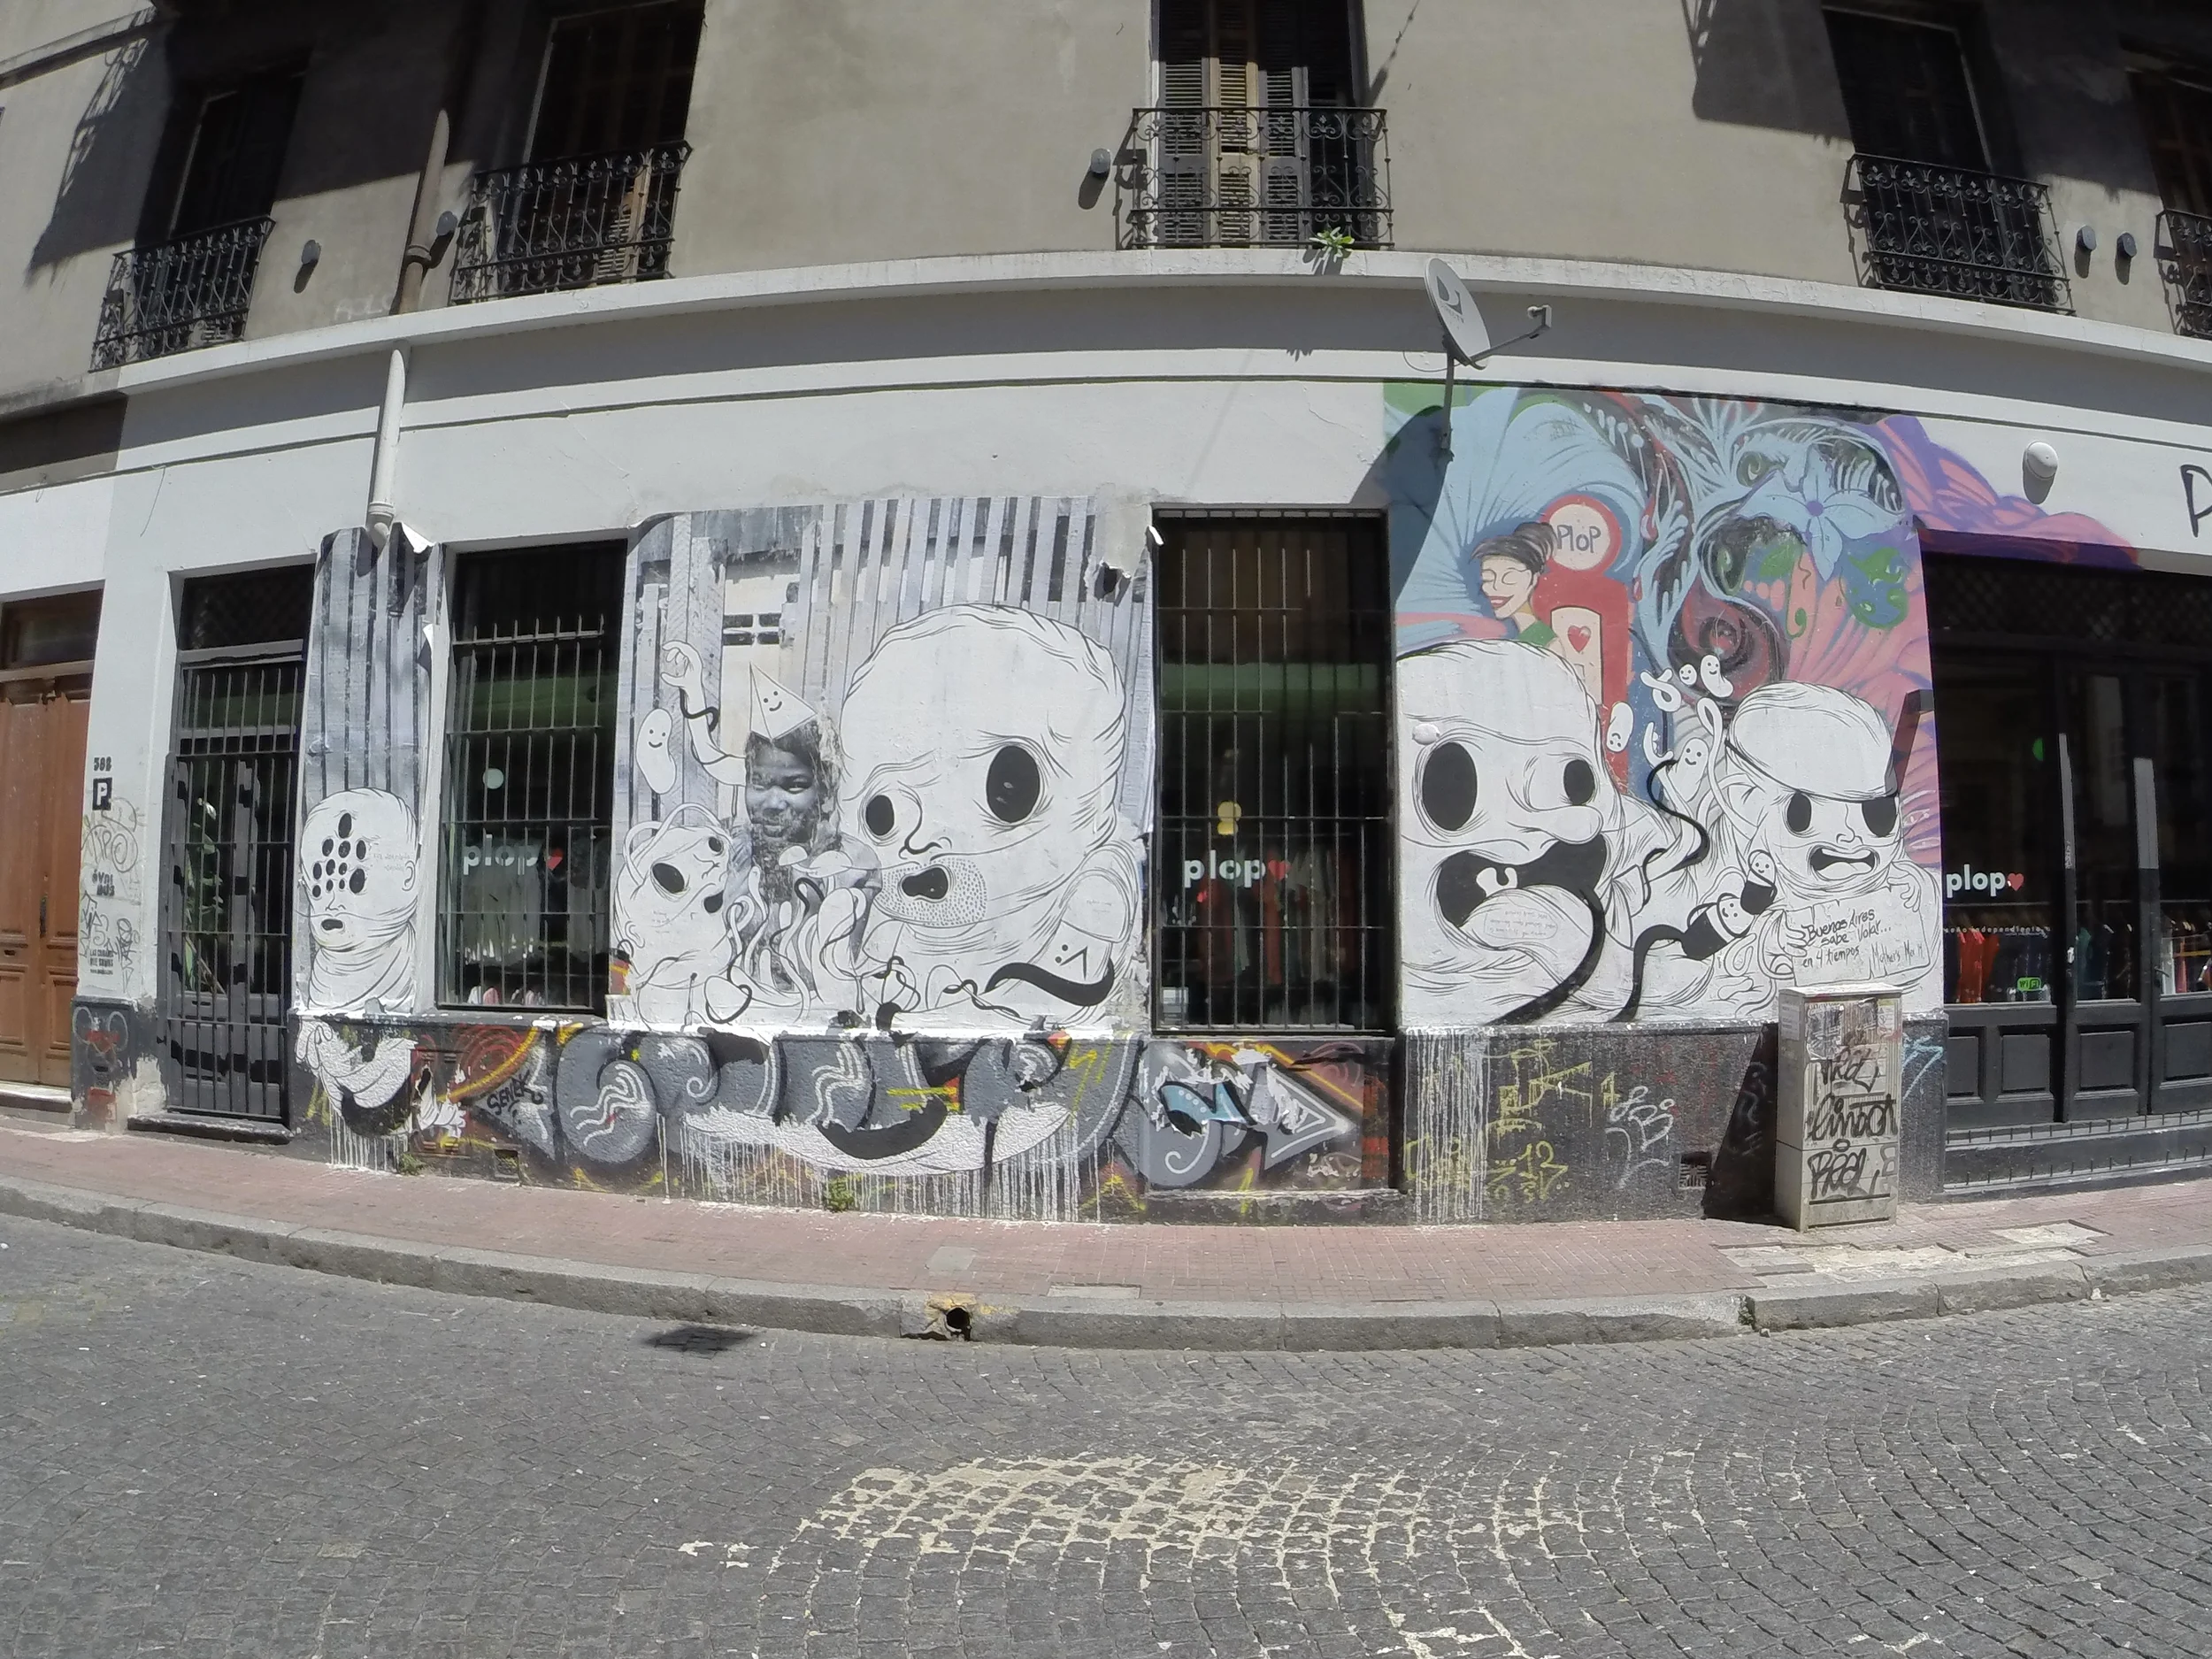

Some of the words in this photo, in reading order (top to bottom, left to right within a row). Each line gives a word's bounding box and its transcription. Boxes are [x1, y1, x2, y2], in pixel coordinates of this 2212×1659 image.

[463, 833, 540, 876] plop
[1184, 849, 1266, 888] plop
[1946, 864, 2006, 898] plop
[1801, 919, 1847, 945] Buenos
[1848, 909, 1875, 928] Aires
[1820, 933, 1849, 948] sabe
[1802, 958, 1813, 968] en
[1816, 949, 1823, 968] 4
[1826, 947, 1859, 966] tiempos
